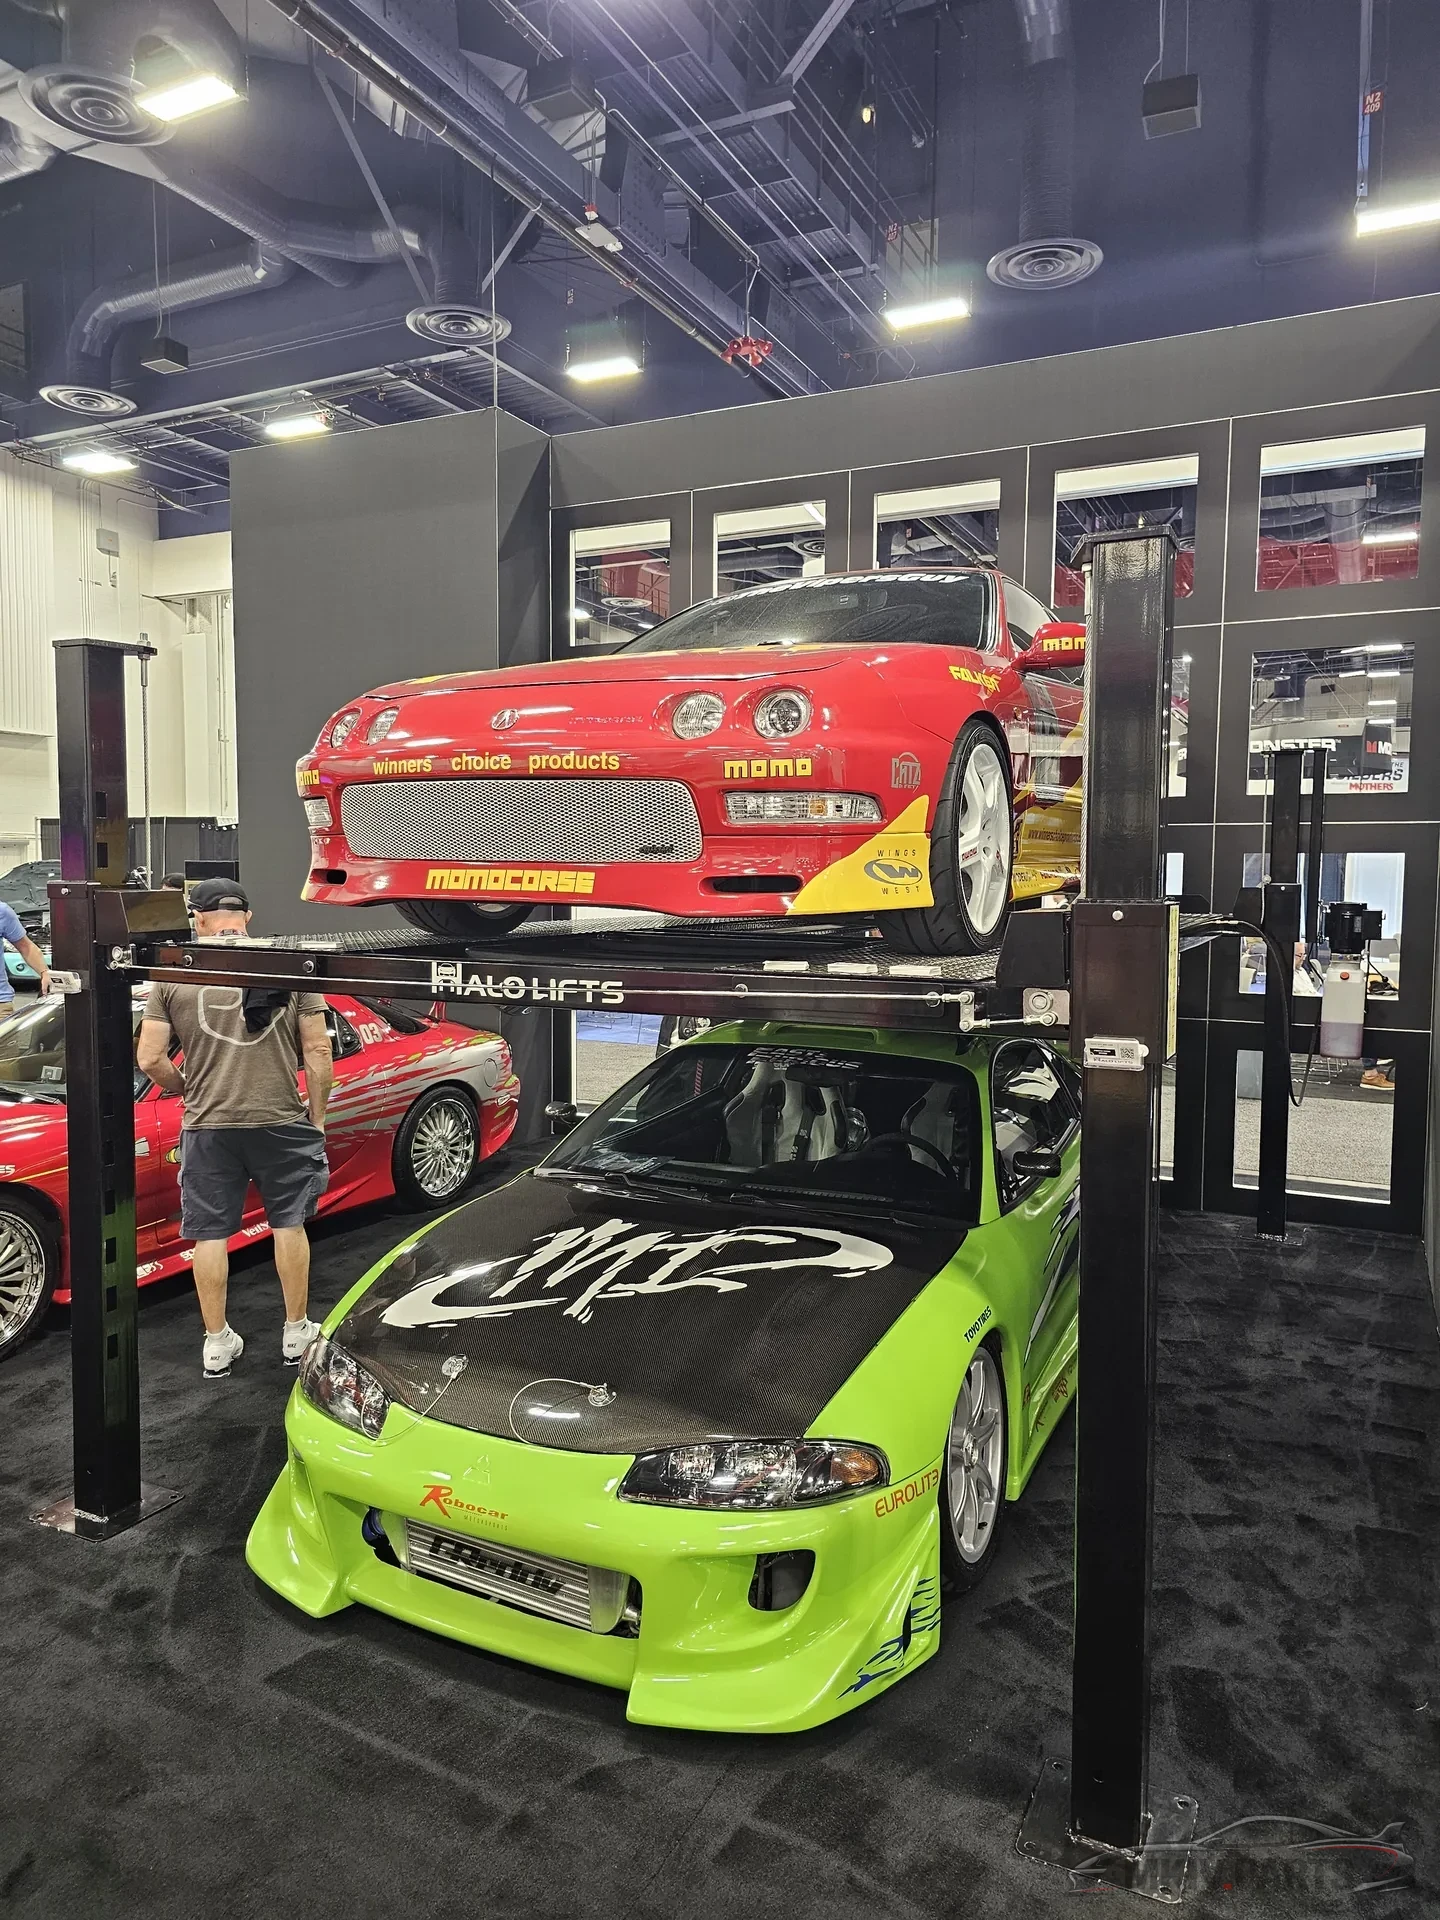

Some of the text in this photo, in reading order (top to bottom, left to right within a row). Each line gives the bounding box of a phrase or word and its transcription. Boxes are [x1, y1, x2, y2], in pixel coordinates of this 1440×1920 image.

[1364, 102, 1381, 114] 409
[373, 751, 620, 775] winners choice products
[724, 757, 813, 779] momo
[1348, 782, 1394, 791] MOTHERS
[877, 849, 917, 857] WINGS
[425, 868, 596, 894] MOMOCORSE
[881, 885, 921, 895] WEST
[532, 978, 625, 1005] LIFTS
[359, 1022, 384, 1045] 03
[419, 1484, 509, 1520] Robocar
